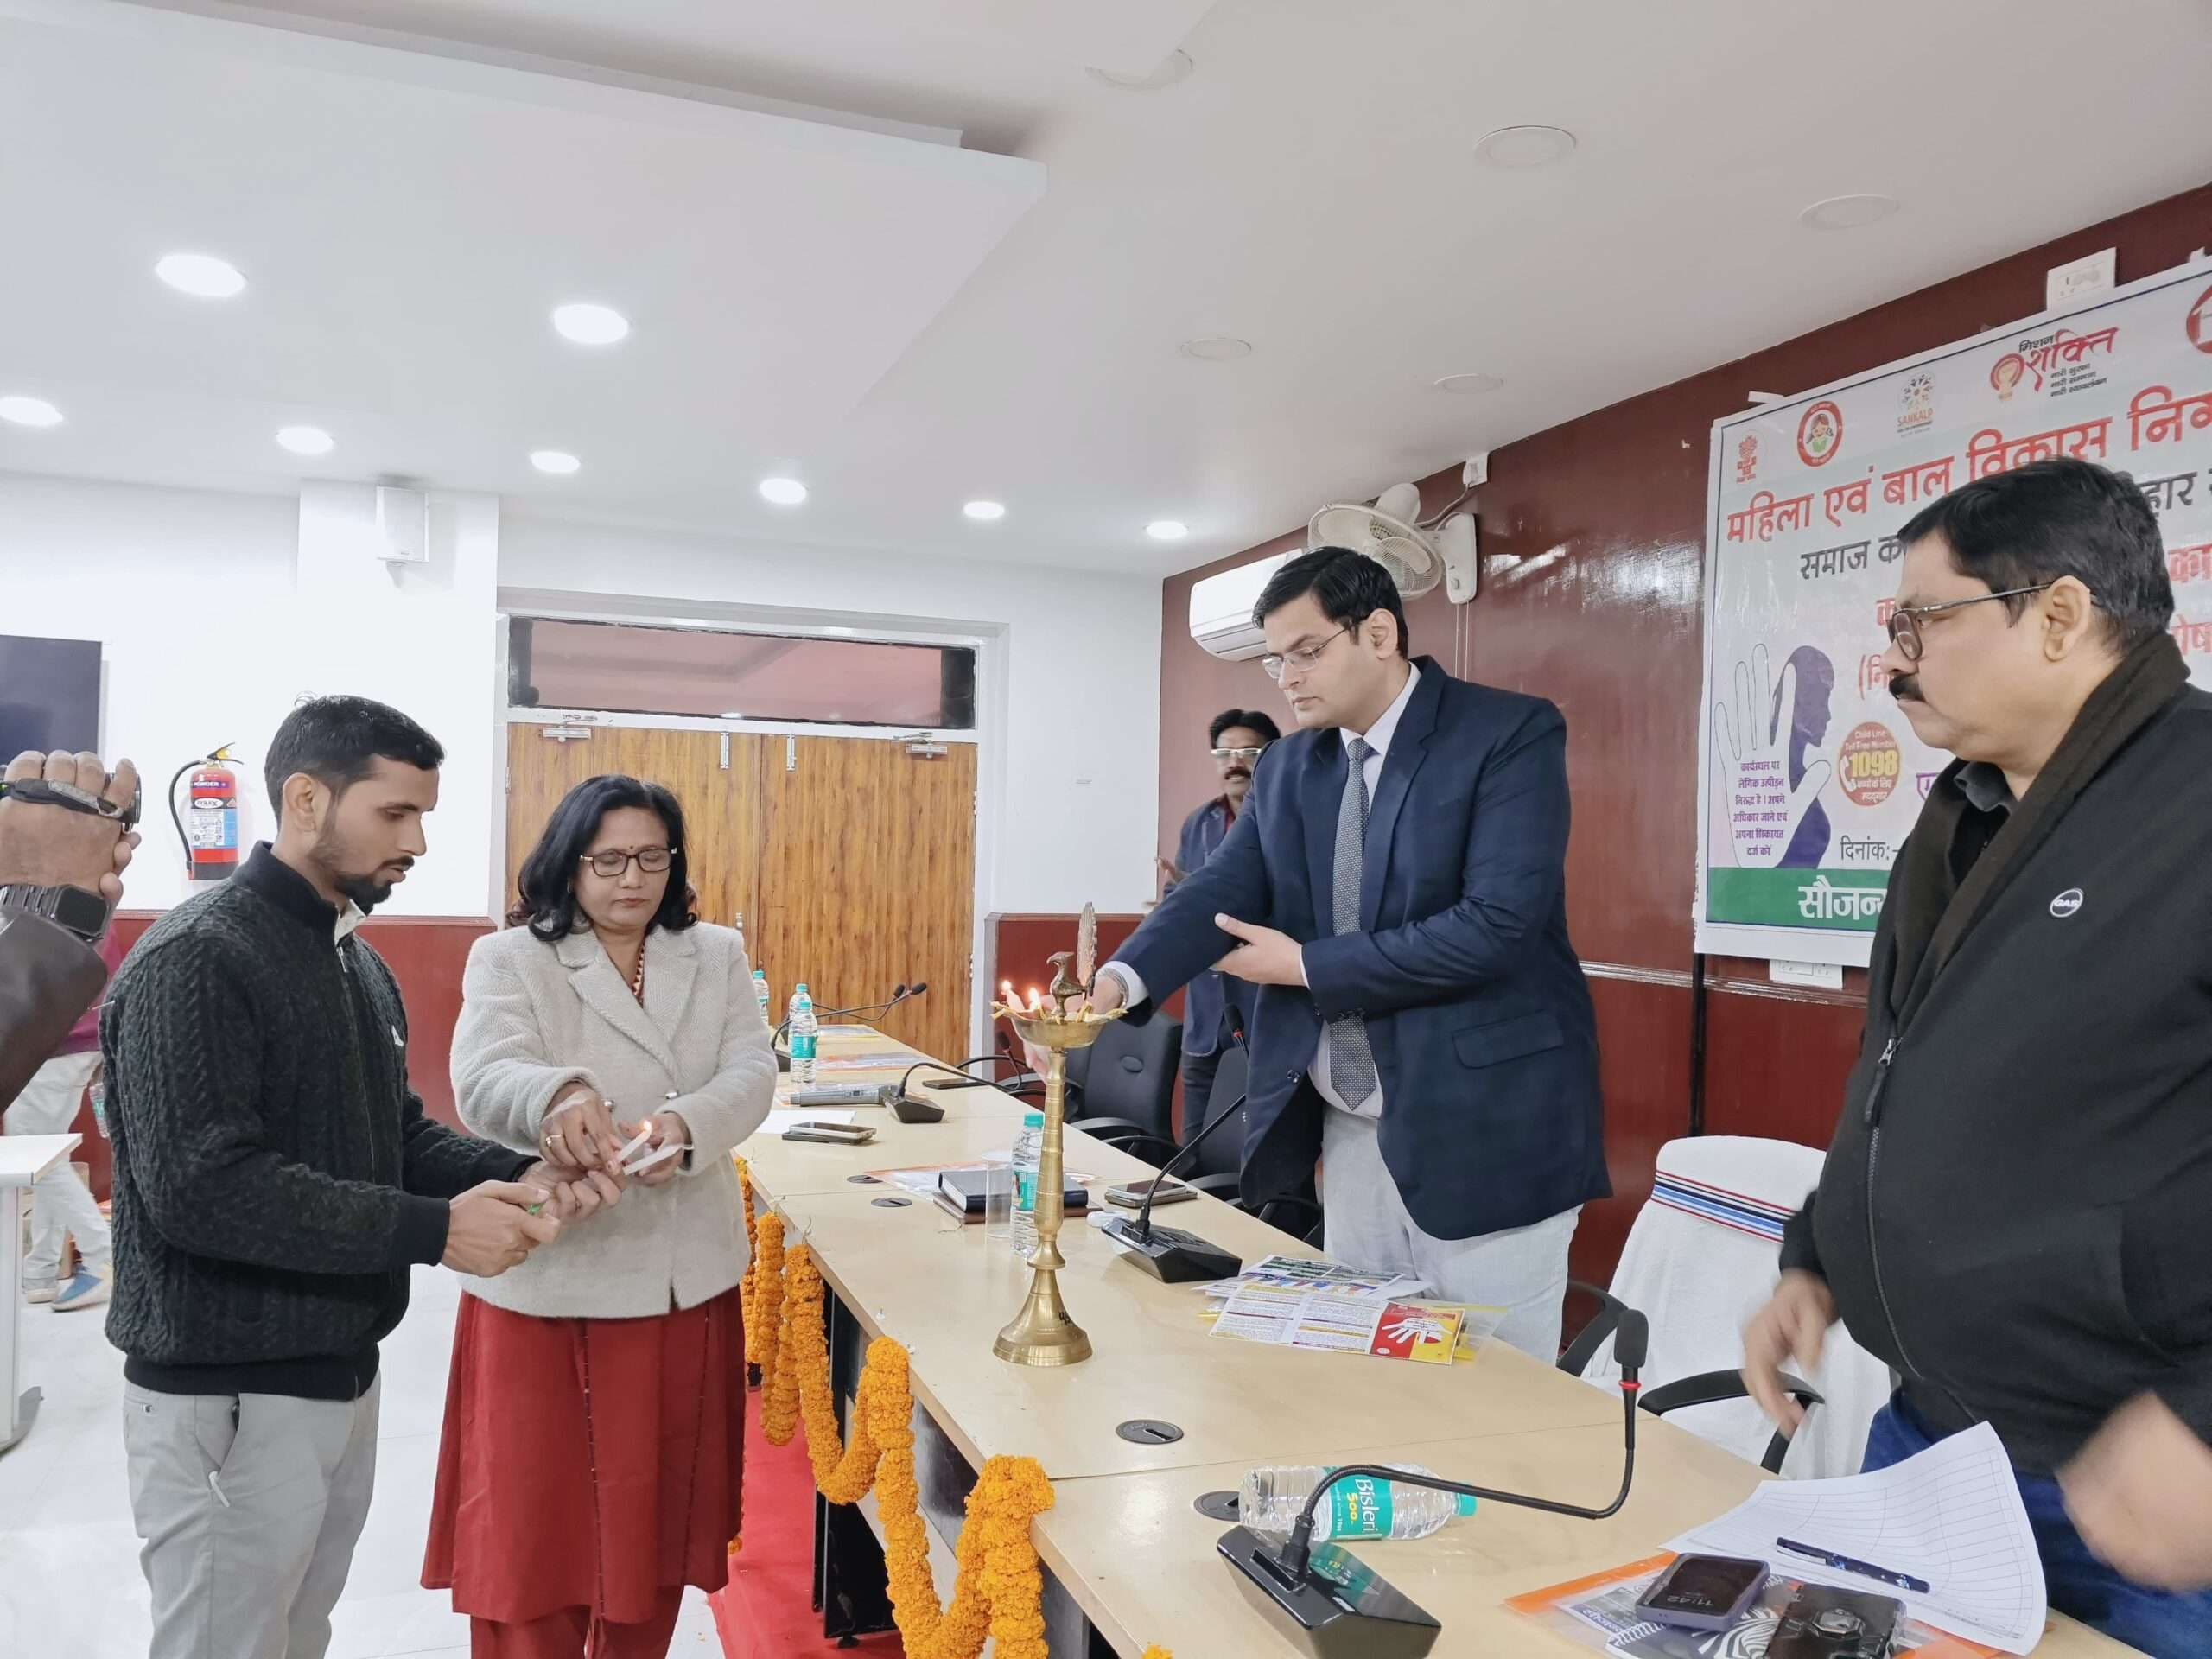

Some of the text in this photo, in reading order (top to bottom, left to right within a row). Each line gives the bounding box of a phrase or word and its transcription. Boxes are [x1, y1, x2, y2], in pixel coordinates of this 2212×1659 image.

[1897, 408, 1933, 426] SANKALP
[1727, 491, 1814, 543] महिला
[1824, 466, 1874, 527] एवं
[1882, 456, 1955, 505] बाल
[1967, 416, 2113, 483] विकास
[1800, 540, 1871, 580] समाज
[1851, 750, 1898, 778] 1098
[1346, 1492, 1358, 1521] 500
[1355, 1478, 1380, 1531] Bisleri
